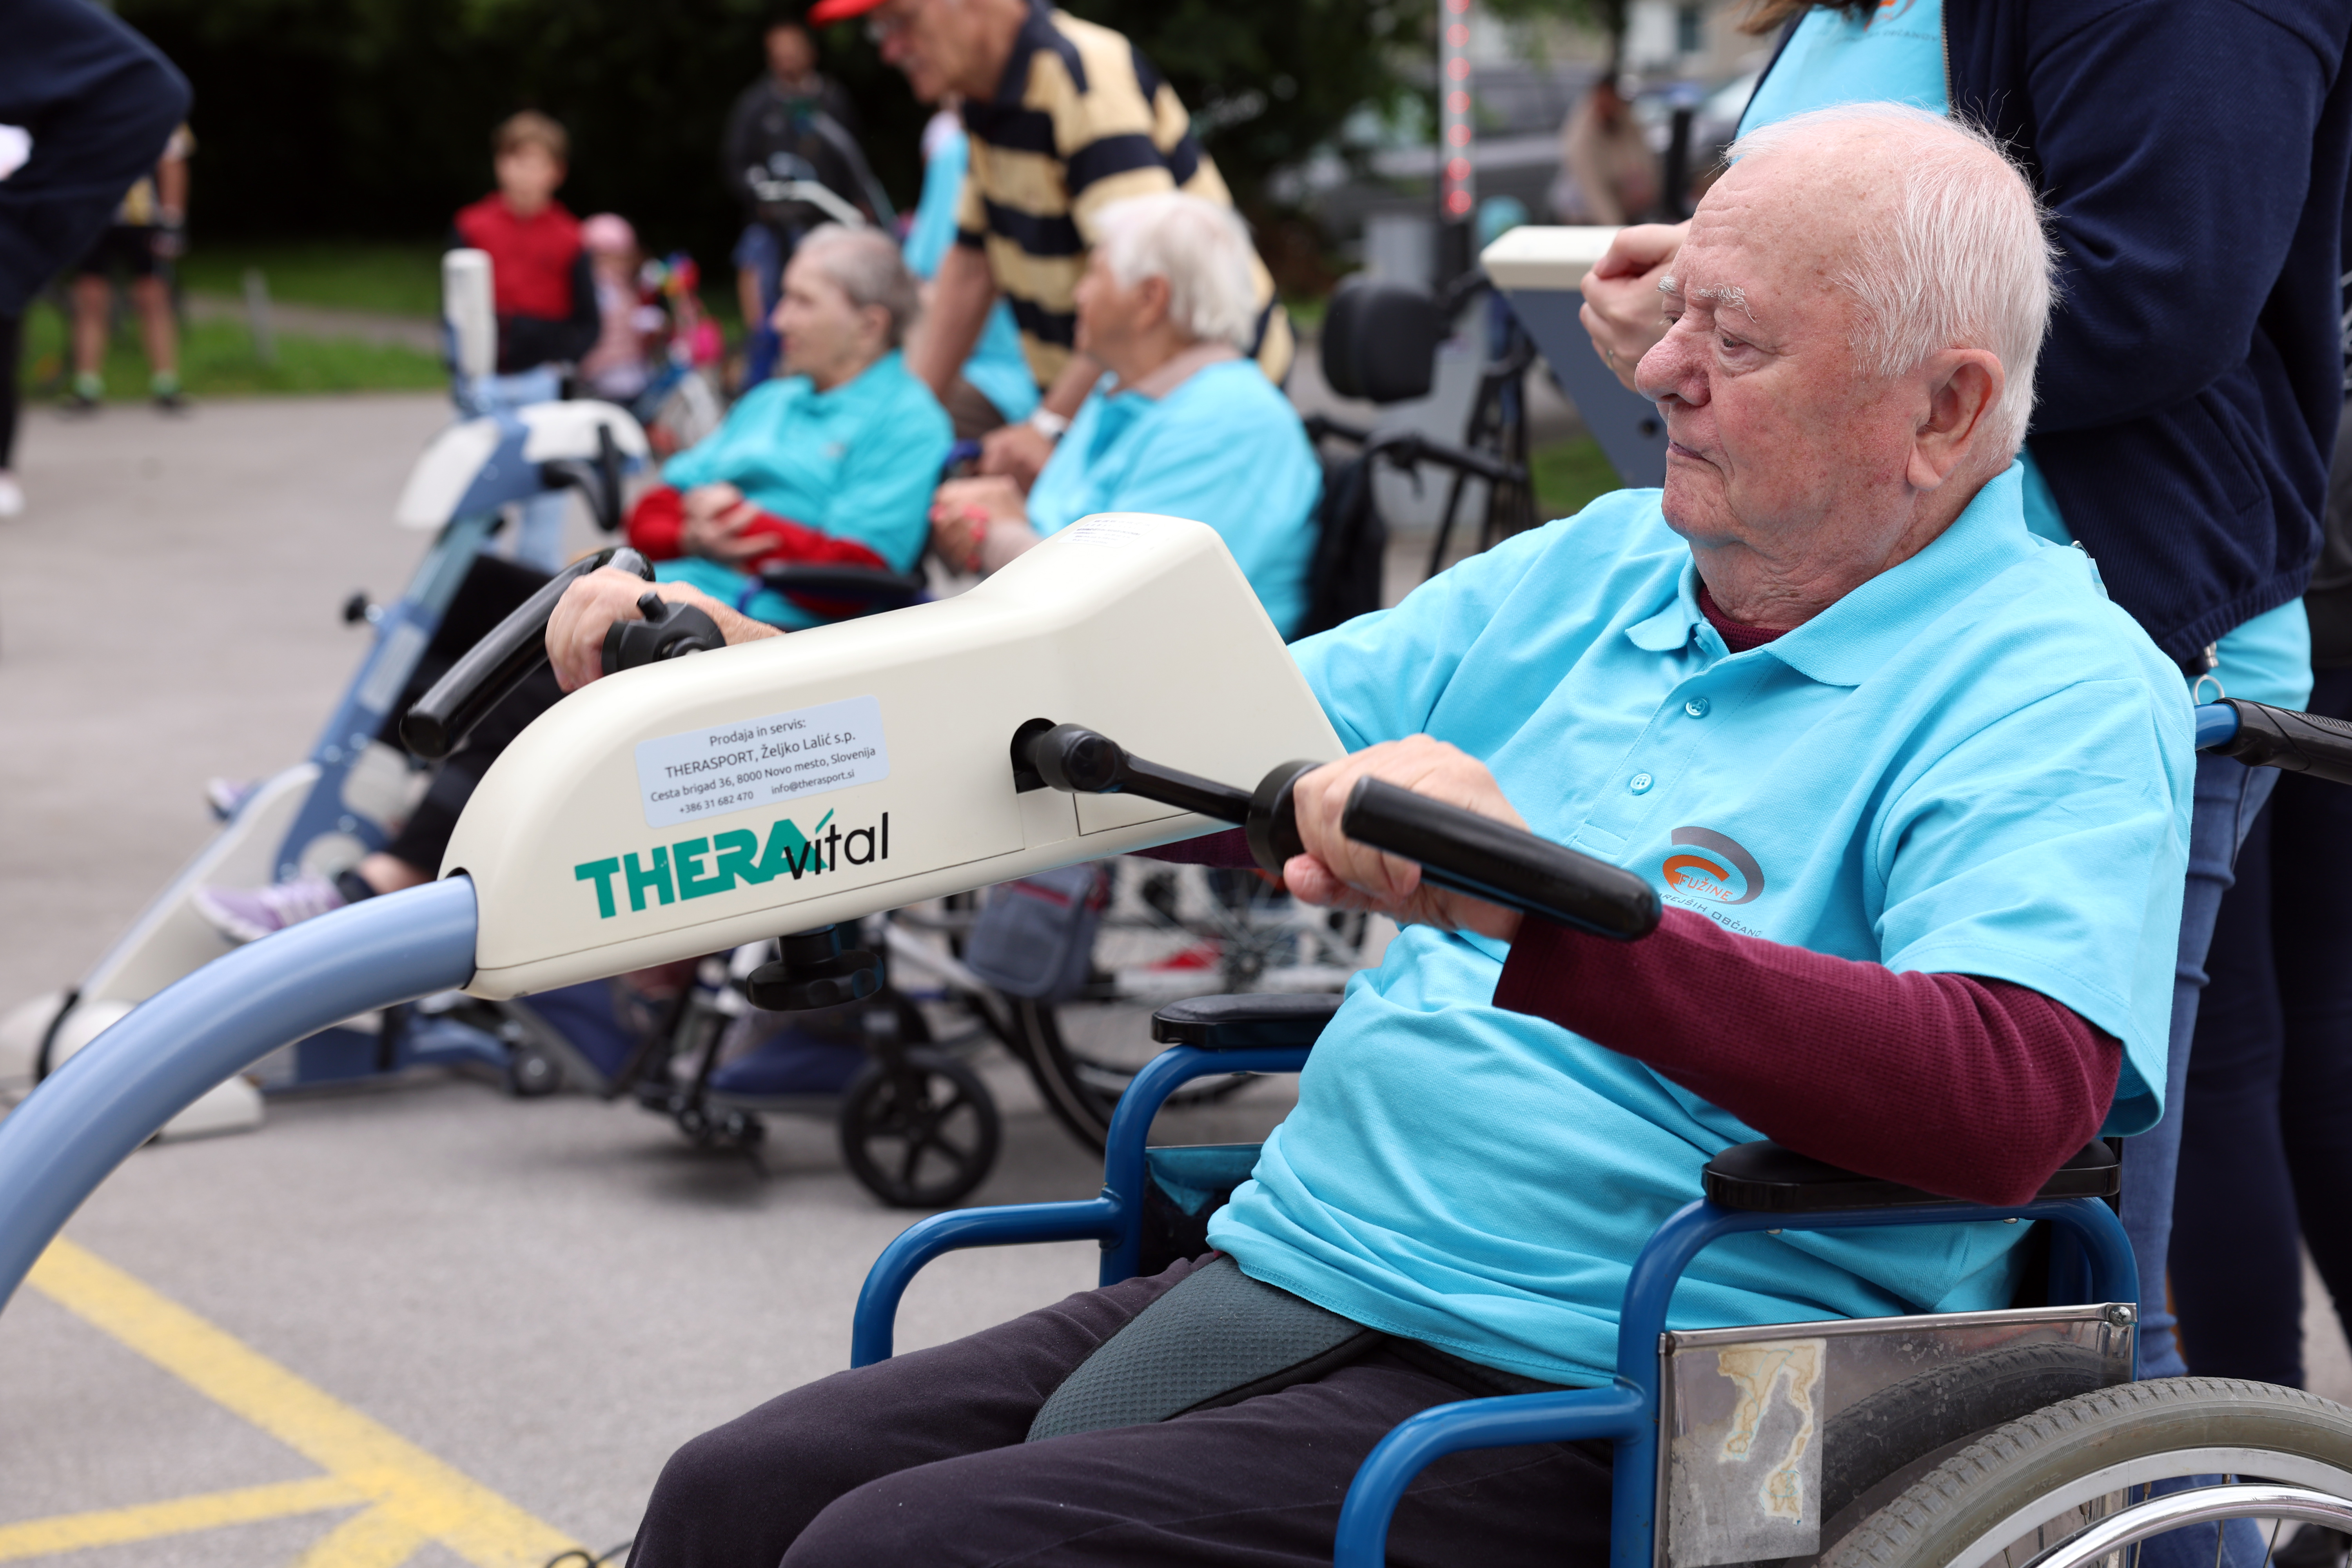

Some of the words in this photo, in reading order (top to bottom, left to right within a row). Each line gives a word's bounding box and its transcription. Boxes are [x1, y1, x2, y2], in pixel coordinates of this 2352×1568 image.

[710, 729, 754, 746] Prodaja
[757, 727, 767, 737] in
[770, 719, 806, 734] servis:
[665, 750, 758, 778] THERASPORT,
[761, 742, 800, 759] Željko
[803, 734, 832, 750] Lalić
[834, 732, 855, 746] s.p.
[651, 789, 681, 802] Cesta
[682, 779, 716, 795] brigad
[719, 777, 735, 788] 36,
[737, 770, 762, 784] 8000
[764, 766, 792, 778] Novo
[794, 759, 829, 771] mesto,
[831, 747, 876, 764] Slovenija
[680, 802, 702, 813] +386
[705, 799, 715, 809] 31
[718, 795, 734, 806] 682
[737, 791, 753, 801] 470
[771, 771, 855, 794] info@therasport.si
[1656, 892, 1708, 912] AREJŠIH
[1679, 874, 1733, 901] FUŽINE
